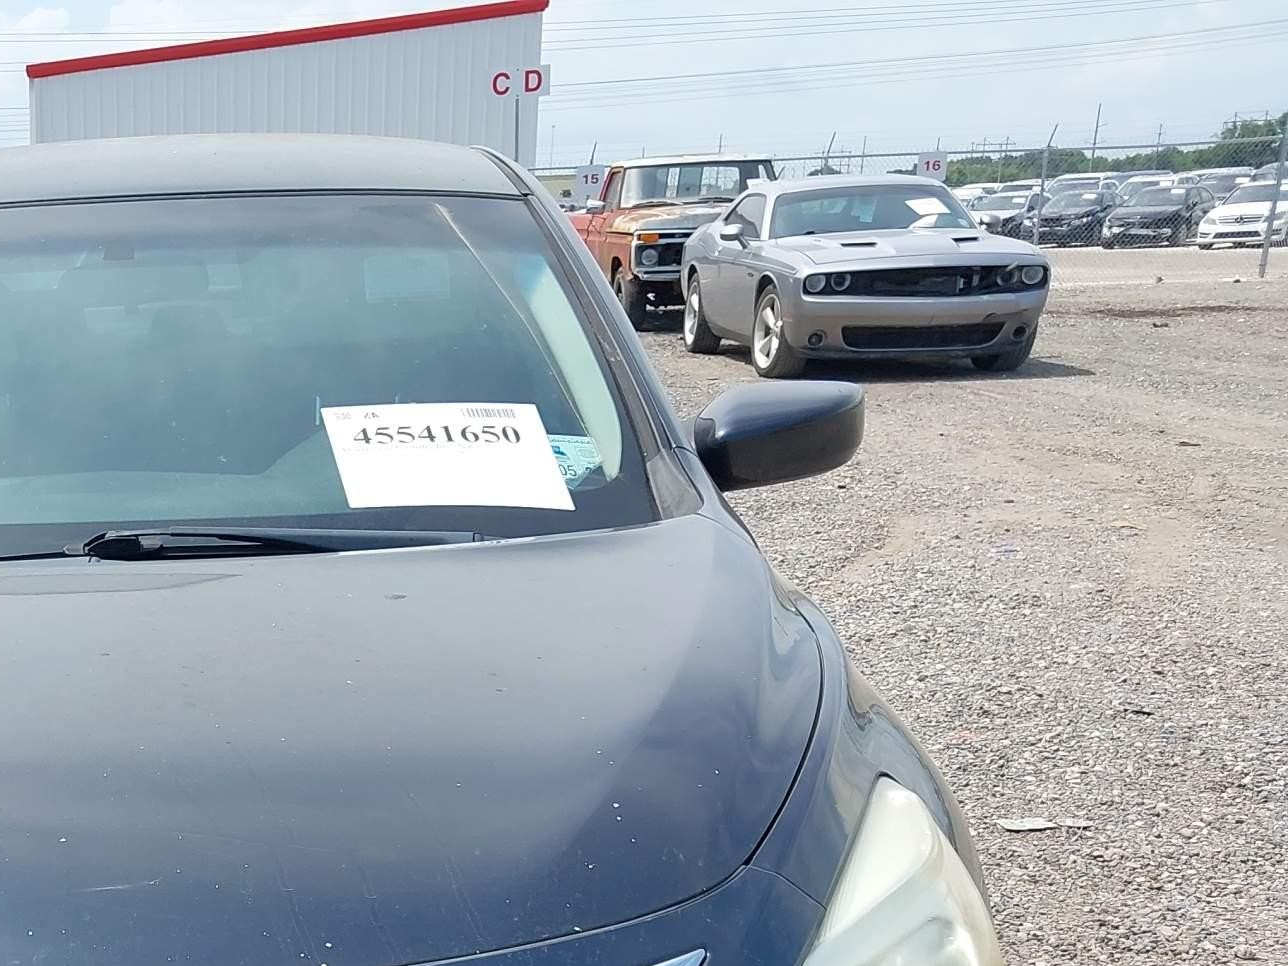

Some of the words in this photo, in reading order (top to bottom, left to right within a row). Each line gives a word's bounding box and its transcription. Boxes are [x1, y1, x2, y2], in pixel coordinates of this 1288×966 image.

[492, 72, 511, 96] C
[524, 69, 543, 93] D
[924, 160, 941, 171] 16
[582, 173, 599, 185] 15
[353, 424, 521, 445] 45541650
